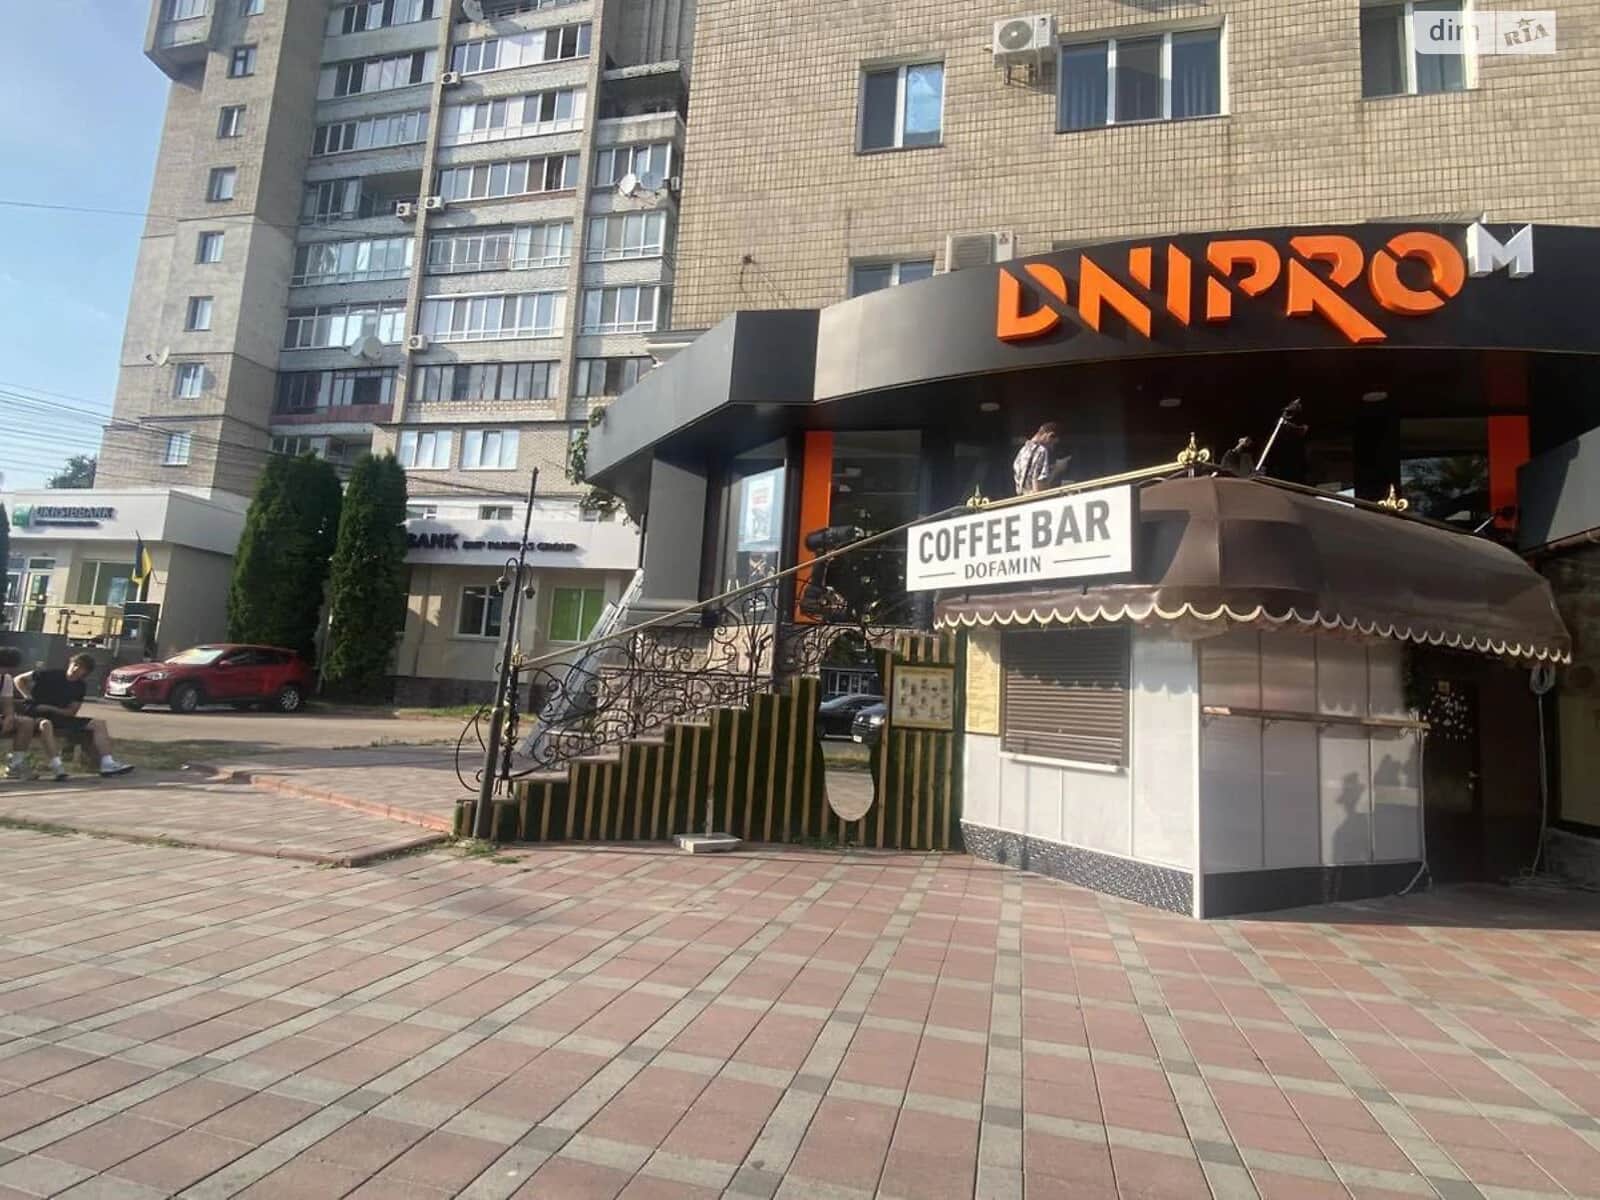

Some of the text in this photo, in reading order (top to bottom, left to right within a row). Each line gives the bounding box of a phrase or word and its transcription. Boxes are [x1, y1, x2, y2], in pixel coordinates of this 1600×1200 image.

[919, 500, 1111, 564] COFFEE BAR
[965, 556, 1042, 580] DOFAMIN
